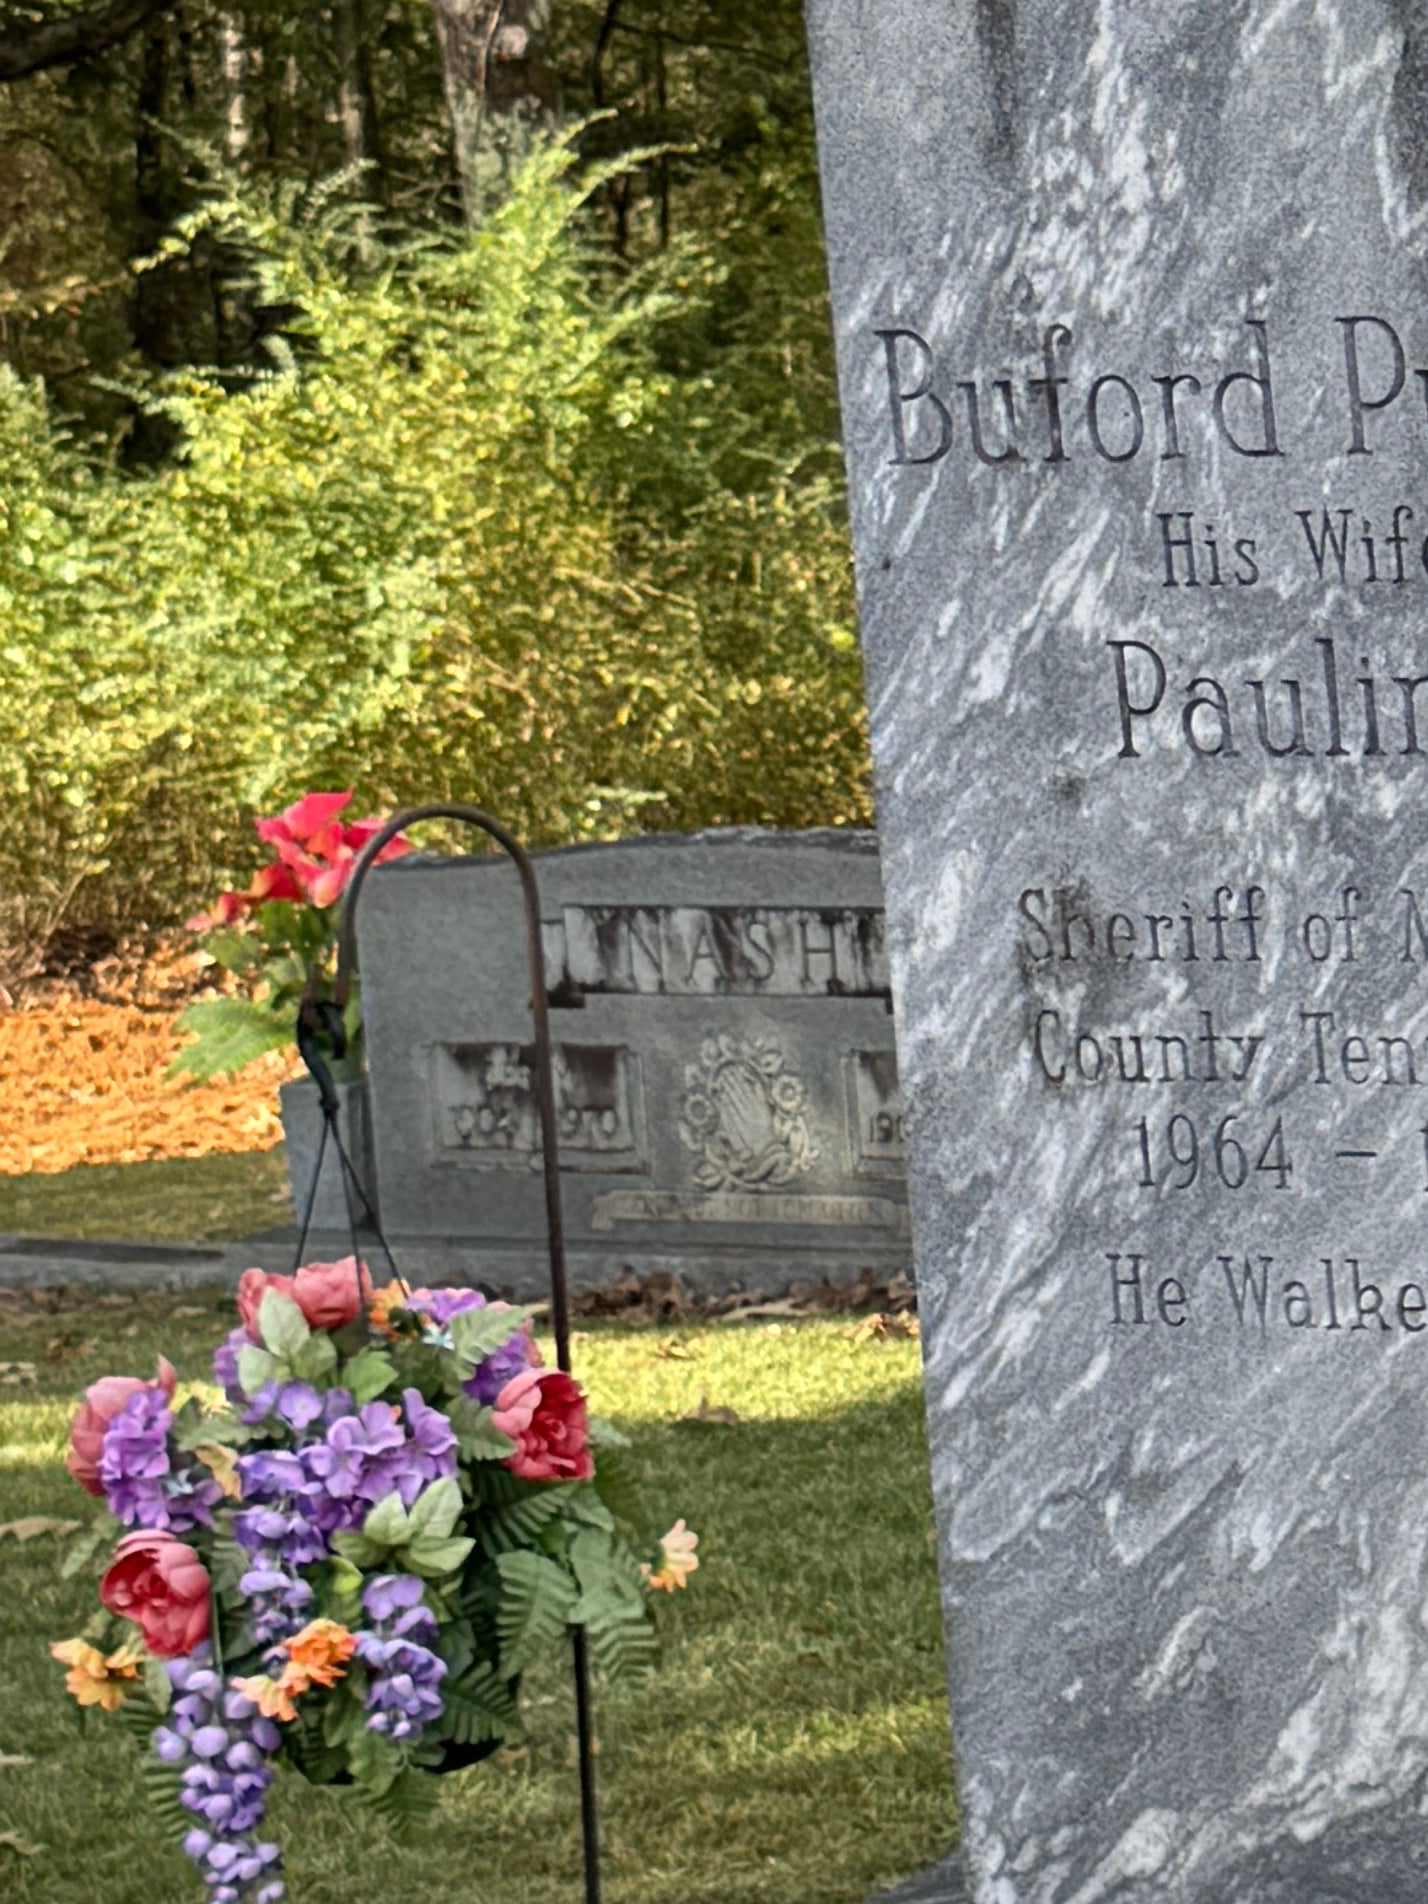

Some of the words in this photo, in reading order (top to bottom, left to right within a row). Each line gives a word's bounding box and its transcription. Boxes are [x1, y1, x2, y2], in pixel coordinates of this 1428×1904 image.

[874, 320, 1286, 466] Buford
[1156, 511, 1259, 588] His
[626, 913, 845, 989] NASH
[1018, 885, 1265, 963] Sheriff
[1304, 886, 1363, 963] of
[1035, 1009, 1264, 1085] County
[1133, 1113, 1294, 1189] 1964
[1105, 1253, 1188, 1328] He
